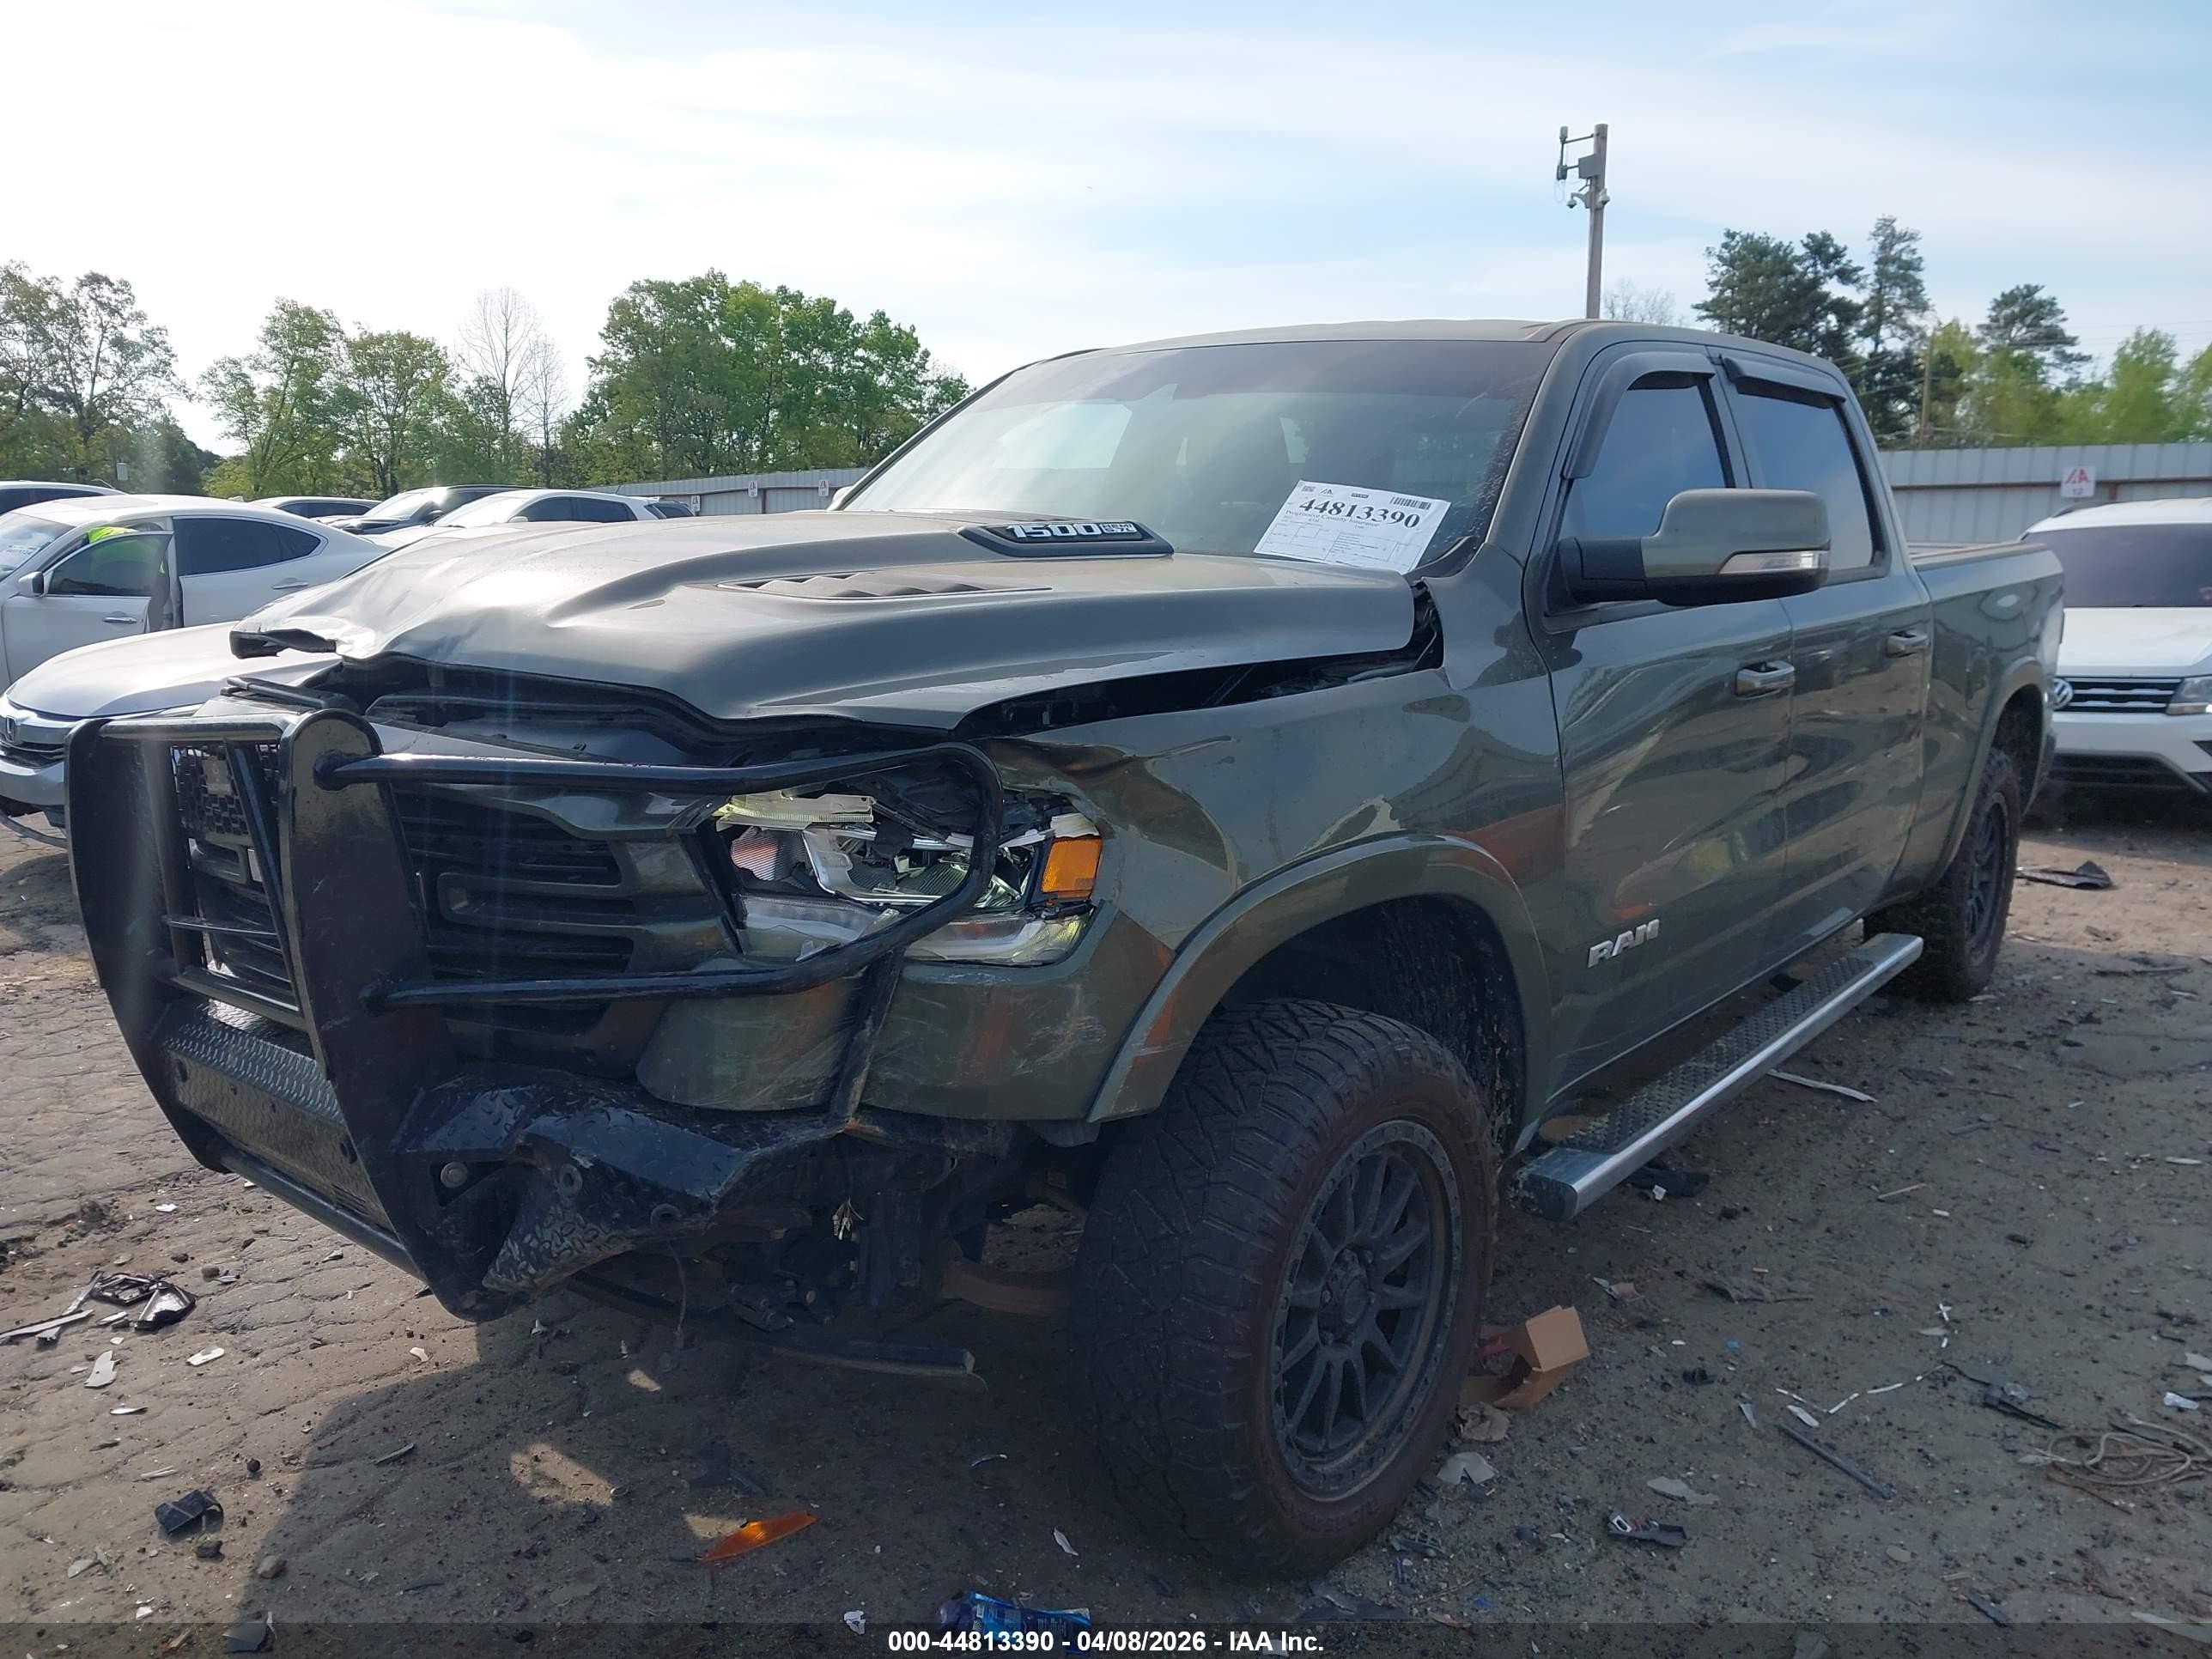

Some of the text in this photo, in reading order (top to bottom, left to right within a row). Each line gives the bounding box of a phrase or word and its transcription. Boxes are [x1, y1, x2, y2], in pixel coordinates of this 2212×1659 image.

[1299, 499, 1420, 528] 44813390
[1007, 523, 1102, 538] 1500
[1587, 918, 1661, 969] RAM
